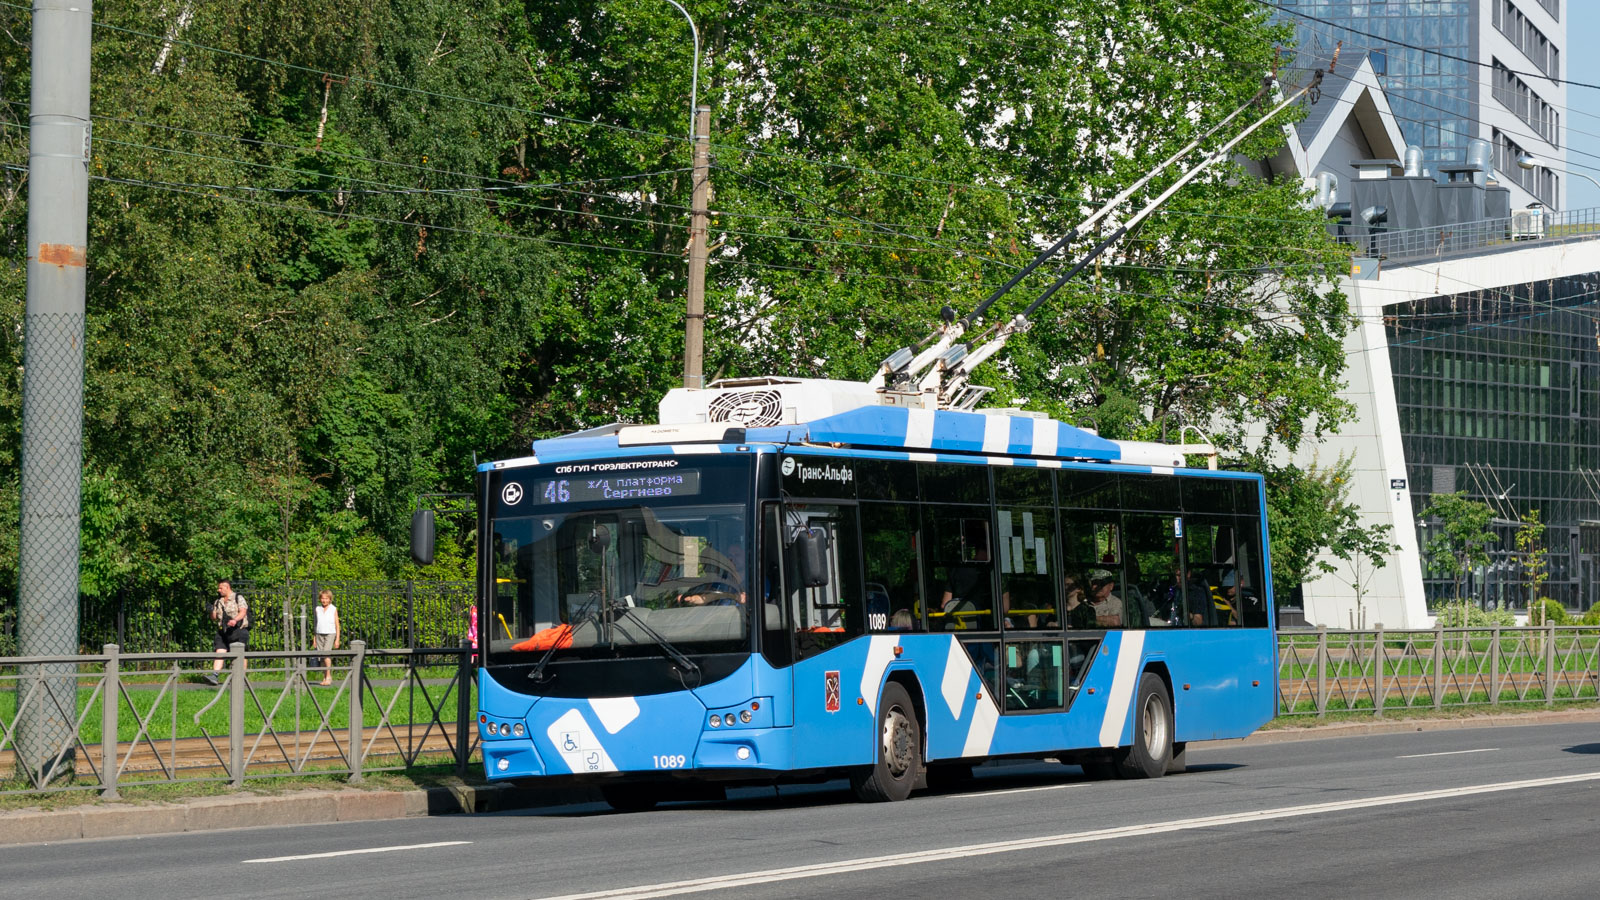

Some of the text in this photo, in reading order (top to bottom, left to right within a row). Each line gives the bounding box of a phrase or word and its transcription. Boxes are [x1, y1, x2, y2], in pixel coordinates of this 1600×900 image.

[573, 464, 590, 473] ГУП
[590, 459, 679, 472] «ГОРЭЛЕКТРОТРАНС»
[796, 462, 853, 485] Транс-Альфа
[587, 475, 684, 490] ж/д платформа
[544, 480, 571, 503] 46
[603, 486, 673, 499] Сергиево
[868, 613, 887, 630] 1089
[653, 754, 686, 769] 1089
